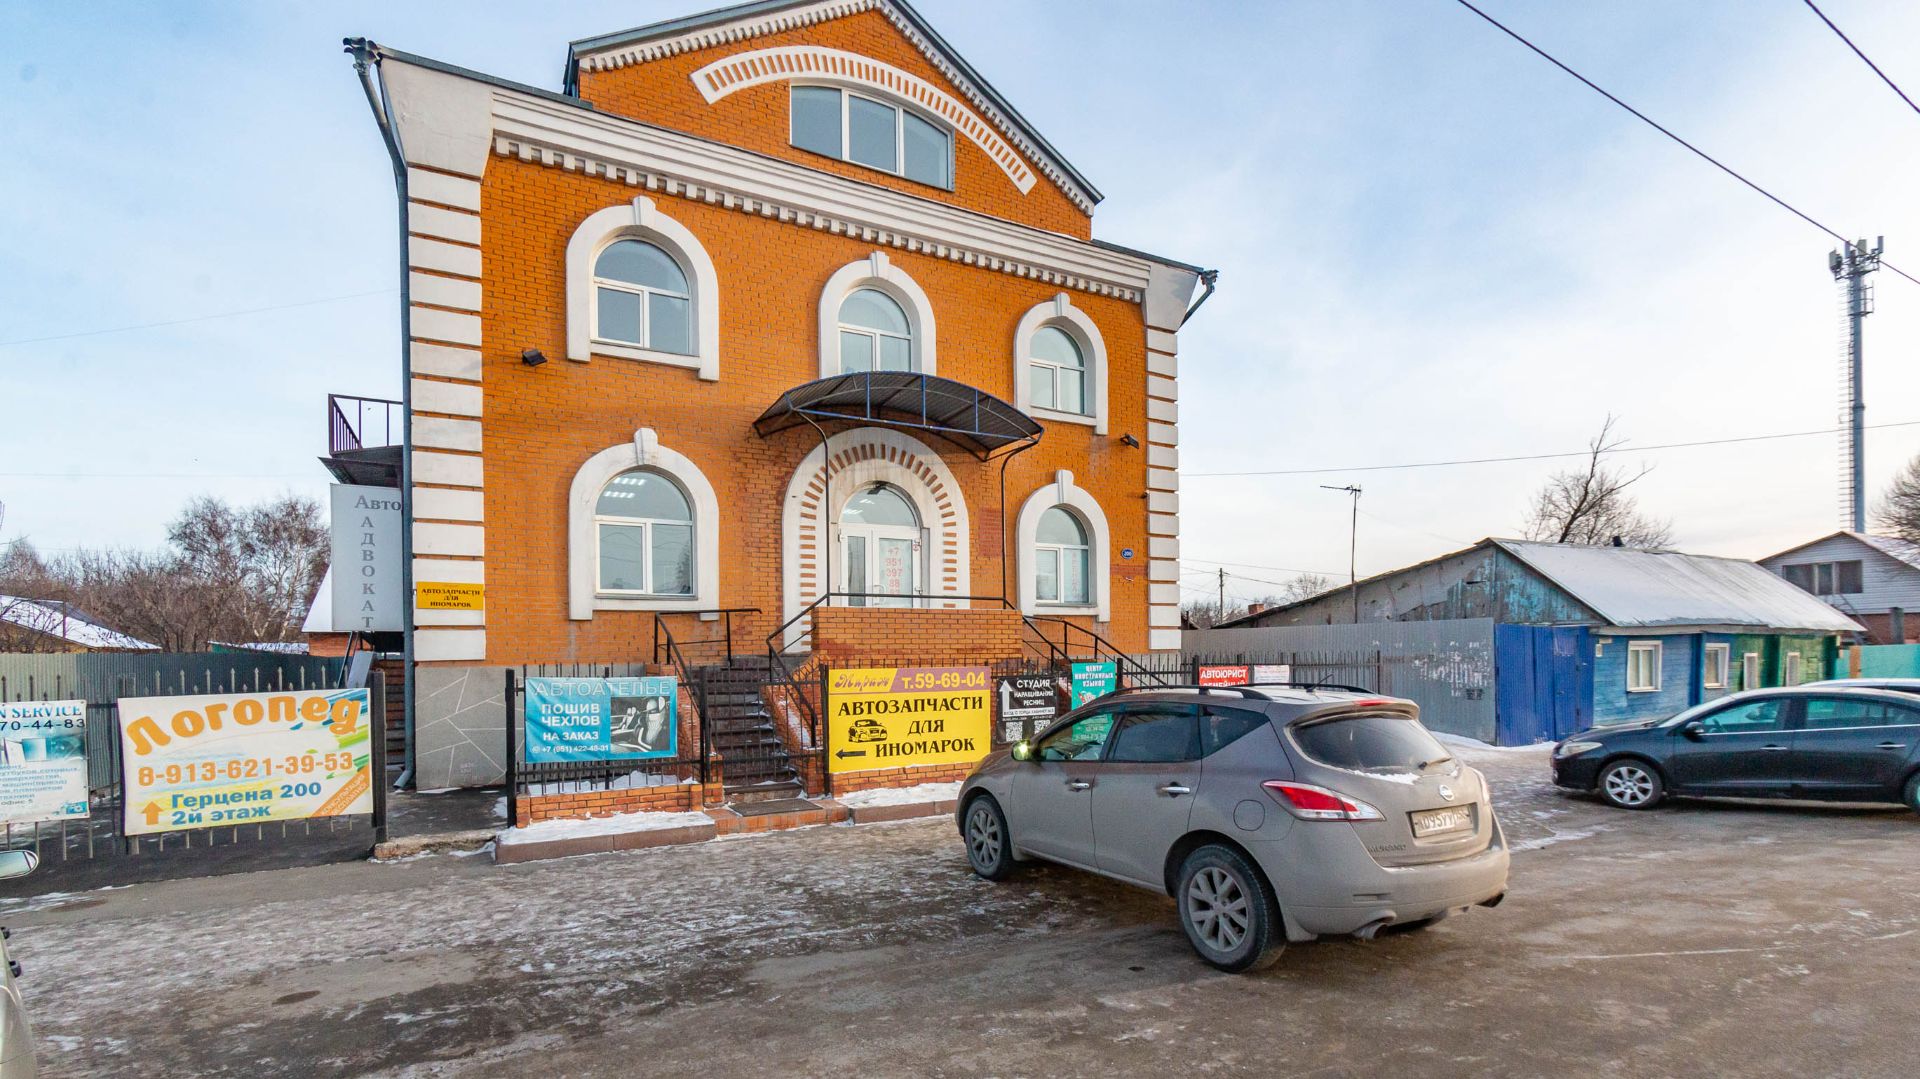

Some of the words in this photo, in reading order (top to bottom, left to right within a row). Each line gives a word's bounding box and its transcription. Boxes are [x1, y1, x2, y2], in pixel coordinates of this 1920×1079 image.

[902, 672, 985, 689] т.59-69-04
[1201, 669, 1247, 679] АВТОЮРИСТ
[534, 680, 671, 697] АВТОАТЕЛЬЕ
[1016, 679, 1051, 689] СТУДИЯ
[12, 705, 82, 718] SERVICE
[541, 703, 601, 715] ПОШИВ
[838, 696, 983, 716] АВТОЗАПЧАСТИ
[126, 695, 361, 756] Логопед
[541, 715, 601, 727] ЧЕХЛОВ
[907, 719, 944, 736] ДЛЯ
[543, 731, 560, 741] НА
[562, 731, 599, 741] ЗАКАЗ
[875, 738, 975, 758] ИНОМАРОК
[138, 752, 353, 787] 8-913-621-39-53
[172, 788, 273, 810] Герцена
[280, 782, 322, 798] 200
[172, 808, 203, 825] 2й
[211, 806, 271, 822] этаж
